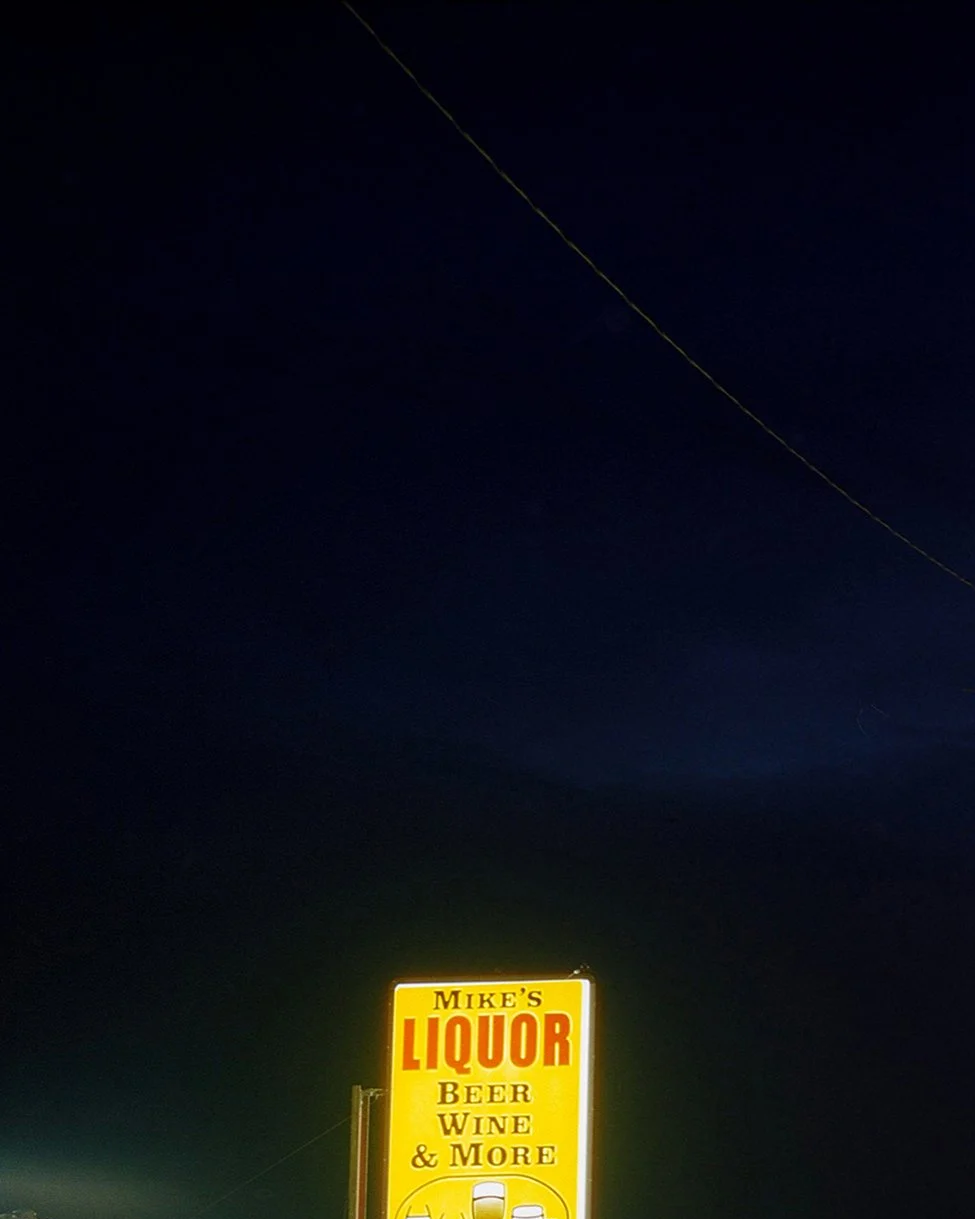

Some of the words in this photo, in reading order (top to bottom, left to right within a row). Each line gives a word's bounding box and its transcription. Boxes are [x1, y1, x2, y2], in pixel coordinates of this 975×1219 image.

[433, 987, 543, 1011] MIKE'S
[401, 1012, 572, 1075] LIQUOR
[437, 1081, 532, 1105] BEER
[437, 1112, 532, 1136] WINE
[411, 1144, 438, 1168] &
[449, 1142, 556, 1166] MORE
